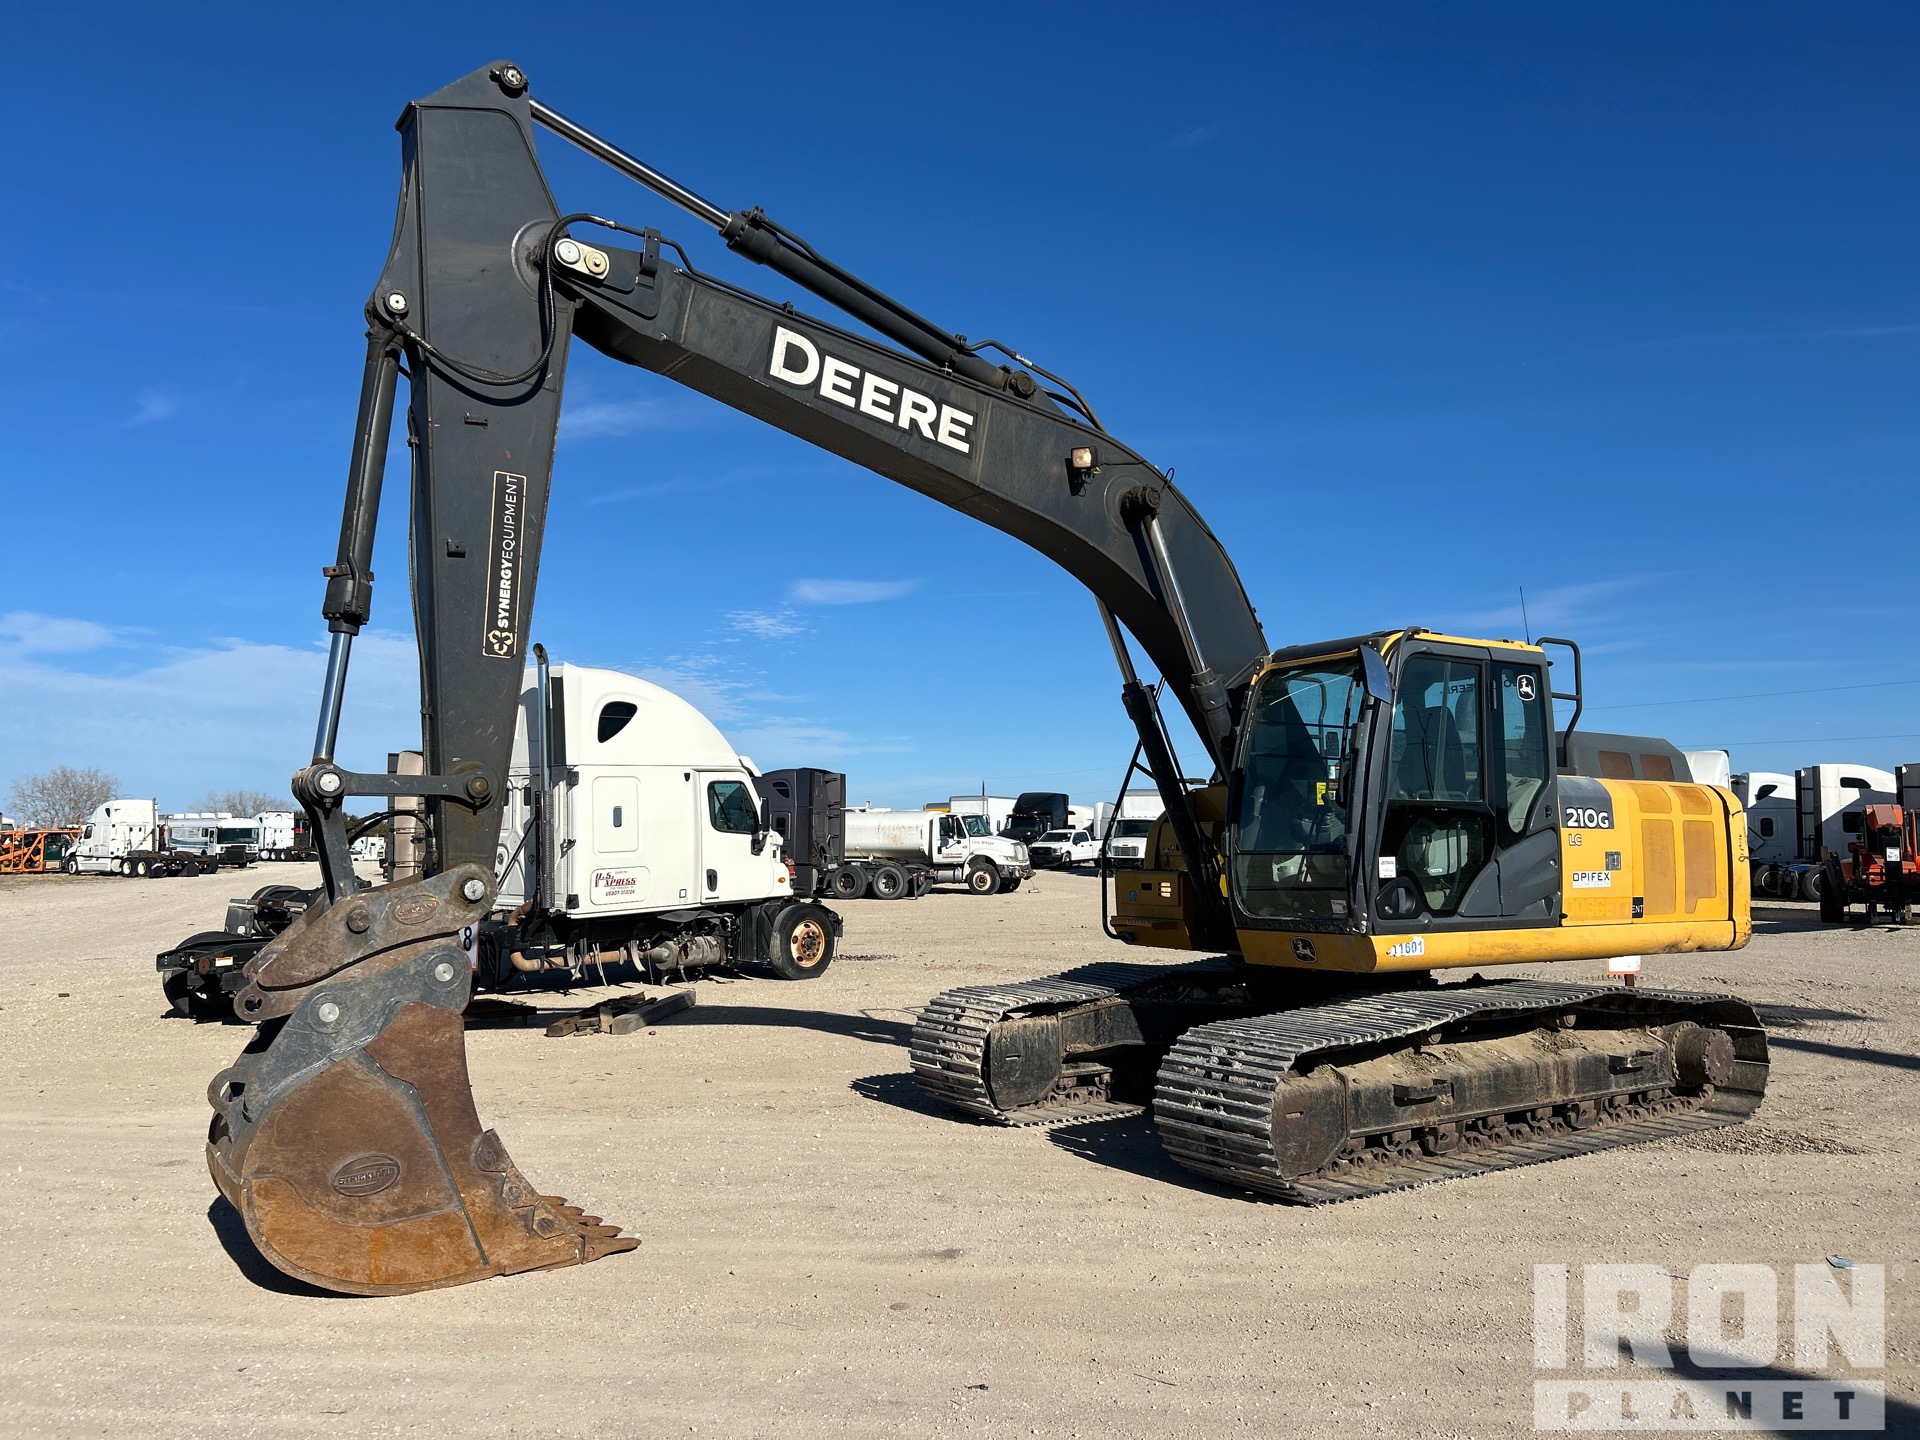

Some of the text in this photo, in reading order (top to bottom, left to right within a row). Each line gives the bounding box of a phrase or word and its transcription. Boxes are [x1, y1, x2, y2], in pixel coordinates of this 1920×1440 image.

[769, 325, 975, 454] DEERE
[1565, 807, 1609, 829] 210G
[1568, 834, 1582, 846] LC
[1572, 872, 1610, 882] OPIFEX
[463, 926, 472, 952] 8
[339, 1167, 395, 1185] STRICKLAND
